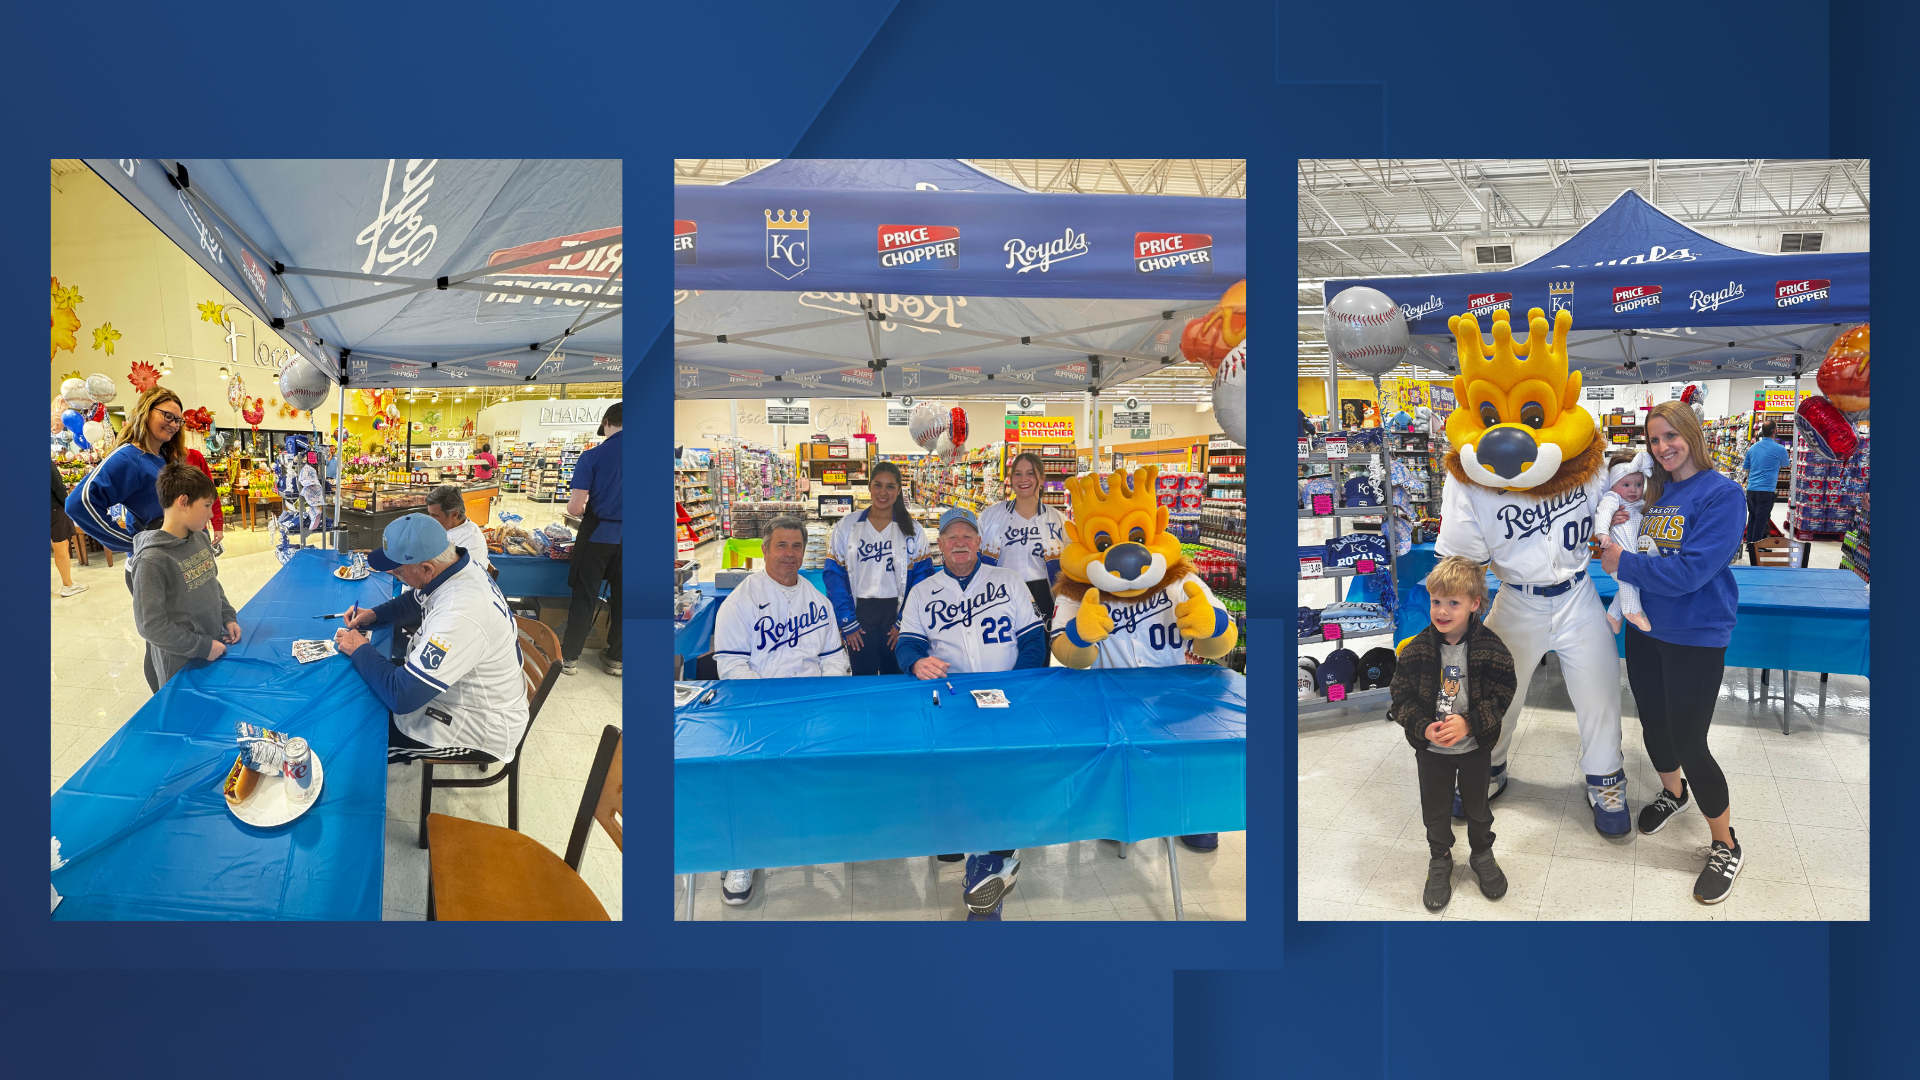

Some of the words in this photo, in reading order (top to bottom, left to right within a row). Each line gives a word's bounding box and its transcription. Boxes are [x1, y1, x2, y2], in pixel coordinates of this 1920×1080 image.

[883, 227, 930, 248] PRICE
[1139, 235, 1184, 255] PRICE
[771, 235, 806, 267] KC
[881, 242, 957, 268] CHOPPER
[1004, 228, 1089, 274] Royals
[1138, 250, 1210, 273] CHOPPER
[1616, 287, 1643, 301] PRICE
[1689, 281, 1745, 314] Royals
[1779, 280, 1809, 297] PRICE
[1400, 295, 1443, 322] Royals
[1471, 294, 1496, 307] PRICE
[1615, 295, 1660, 314] CHOPPER
[1778, 290, 1828, 308] CHOPPER
[904, 397, 912, 405] 2
[1022, 398, 1029, 406] 3
[1129, 400, 1136, 408] 4
[1021, 429, 1073, 438] STRETCHER
[1028, 421, 1066, 429] DOLLAR
[1334, 444, 1346, 454] $2.99
[1358, 483, 1370, 496] KC
[1563, 516, 1592, 552] 00
[1639, 515, 1685, 542] YALS
[1309, 563, 1322, 573] $3.49
[924, 581, 1010, 631] Royals
[754, 601, 830, 653] Royals
[981, 616, 1013, 645] 22
[422, 644, 442, 669] KC
[1602, 776, 1618, 786] CITY
